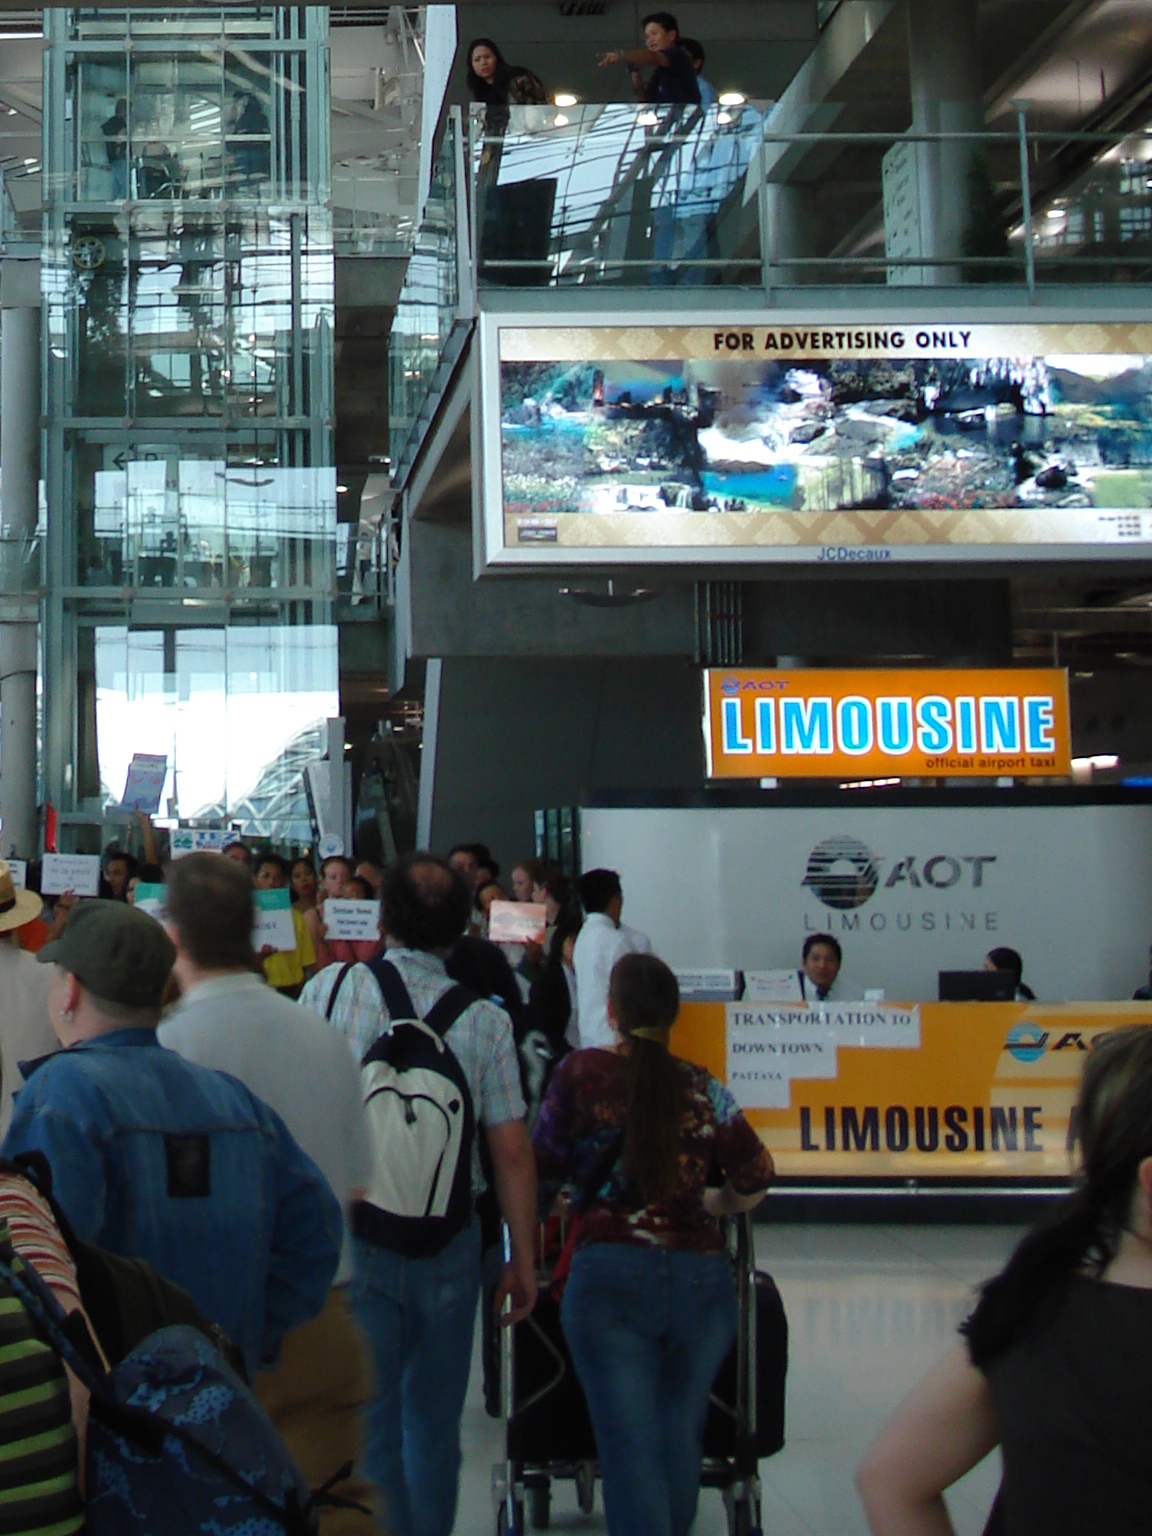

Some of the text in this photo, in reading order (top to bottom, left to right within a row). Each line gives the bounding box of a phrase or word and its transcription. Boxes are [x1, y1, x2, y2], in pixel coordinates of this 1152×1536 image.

[714, 331, 971, 350] FOR ADVERTISING ONLY
[817, 546, 891, 560] JCDecaux
[742, 680, 790, 690] AOT
[721, 696, 1056, 754] LIMOUSINE
[926, 757, 1055, 770] official airport taxi
[885, 855, 997, 887] AOT
[804, 912, 997, 931] LIMOUSINE
[733, 1012, 886, 1026] TRANSPORTATION
[732, 1071, 783, 1081] PATTAYA
[800, 1105, 1043, 1152] LIMOUSINE
